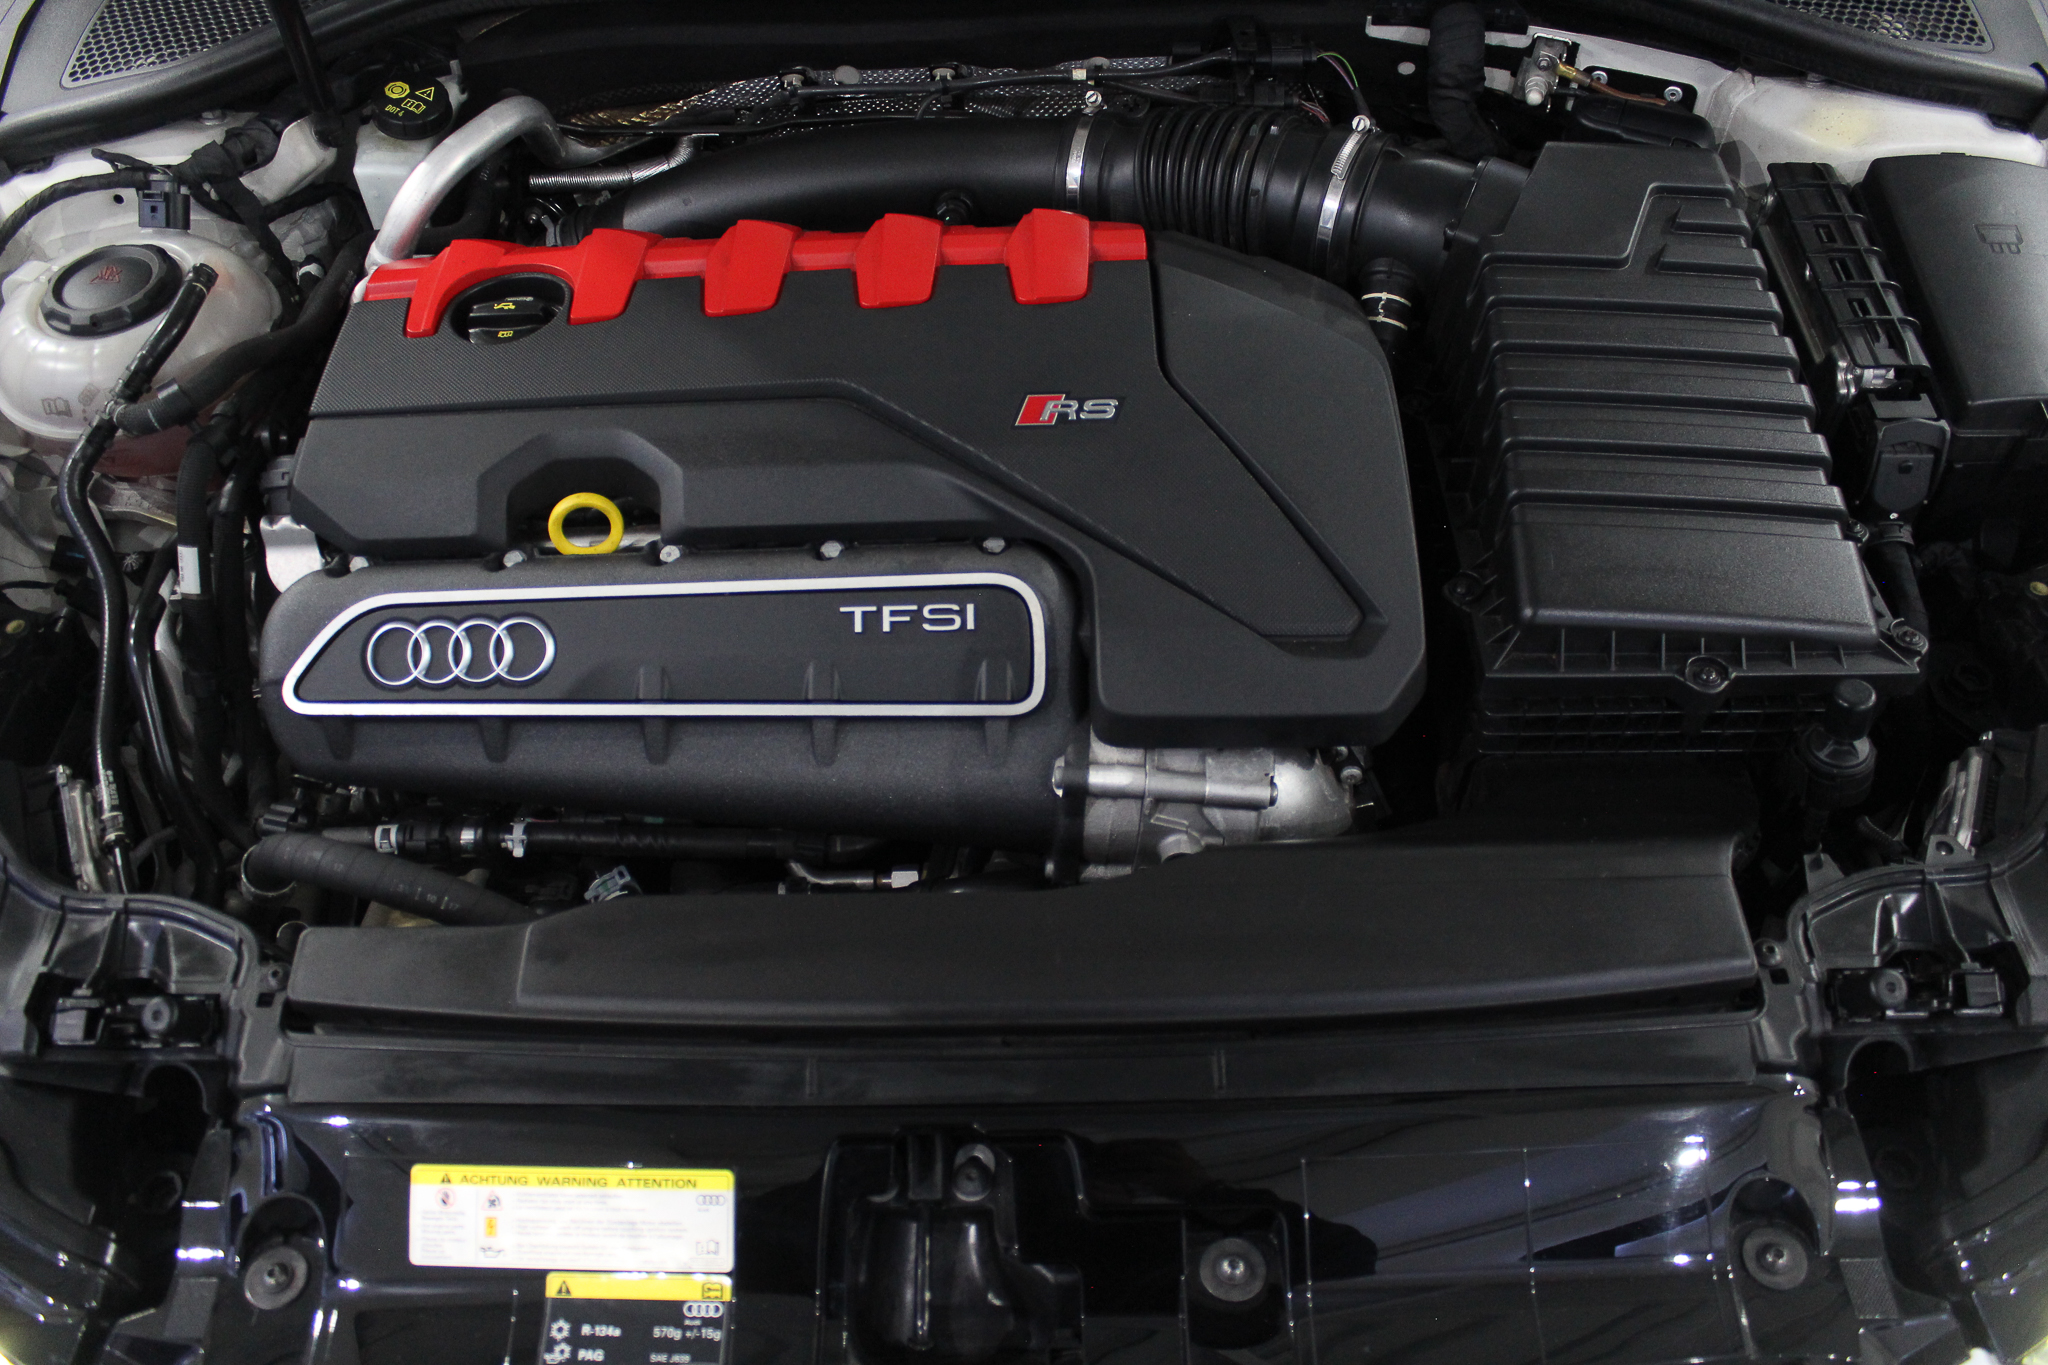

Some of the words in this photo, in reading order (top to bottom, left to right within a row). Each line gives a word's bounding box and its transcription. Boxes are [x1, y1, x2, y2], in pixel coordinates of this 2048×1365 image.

[385, 104, 401, 114] DOT
[1040, 399, 1119, 421] RS
[839, 603, 975, 633] TFSI
[460, 1175, 529, 1187] ACHTUNG
[536, 1177, 608, 1189] WARNING
[616, 1178, 697, 1190] ATTENTION
[581, 1323, 622, 1338] R-134a
[653, 1326, 683, 1341] 570g
[578, 1348, 605, 1362] PAG
[650, 1352, 668, 1363] SAE
